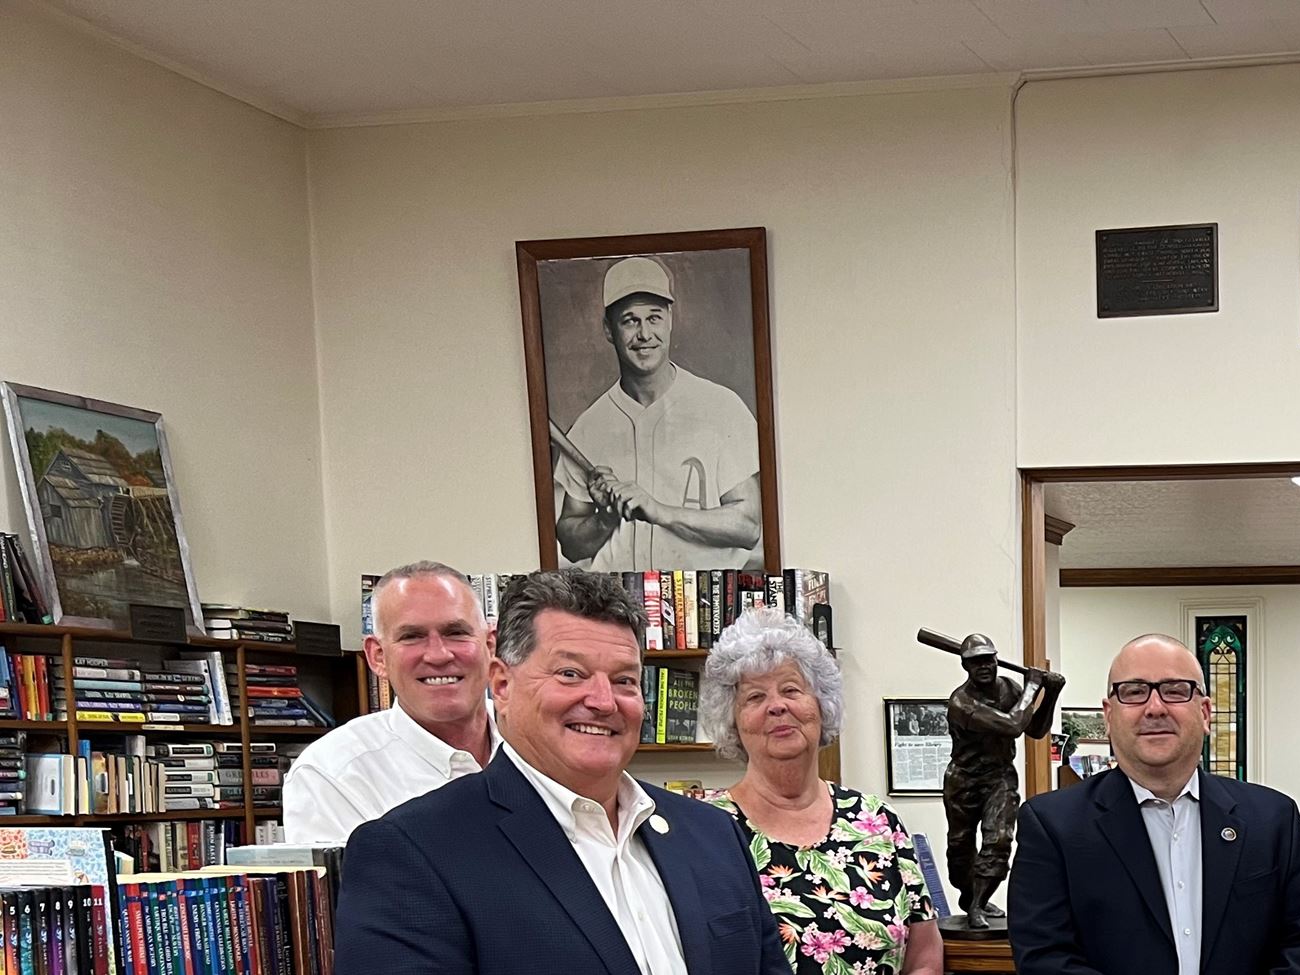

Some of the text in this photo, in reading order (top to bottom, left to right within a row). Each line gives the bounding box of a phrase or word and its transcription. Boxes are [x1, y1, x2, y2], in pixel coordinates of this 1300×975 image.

[681, 456, 706, 510] A
[676, 578, 684, 614] STEPHEN
[769, 580, 777, 607] STAND
[669, 689, 697, 699] BROKEN
[669, 701, 696, 710] PEOPLE
[55, 901, 61, 910] 8
[67, 900, 73, 909] 9
[83, 898, 91, 907] 10
[93, 897, 102, 906] 11
[10, 906, 16, 915] 5
[24, 905, 31, 914] 6
[40, 903, 45, 912] 7
[145, 915, 153, 943] AMERICAN
